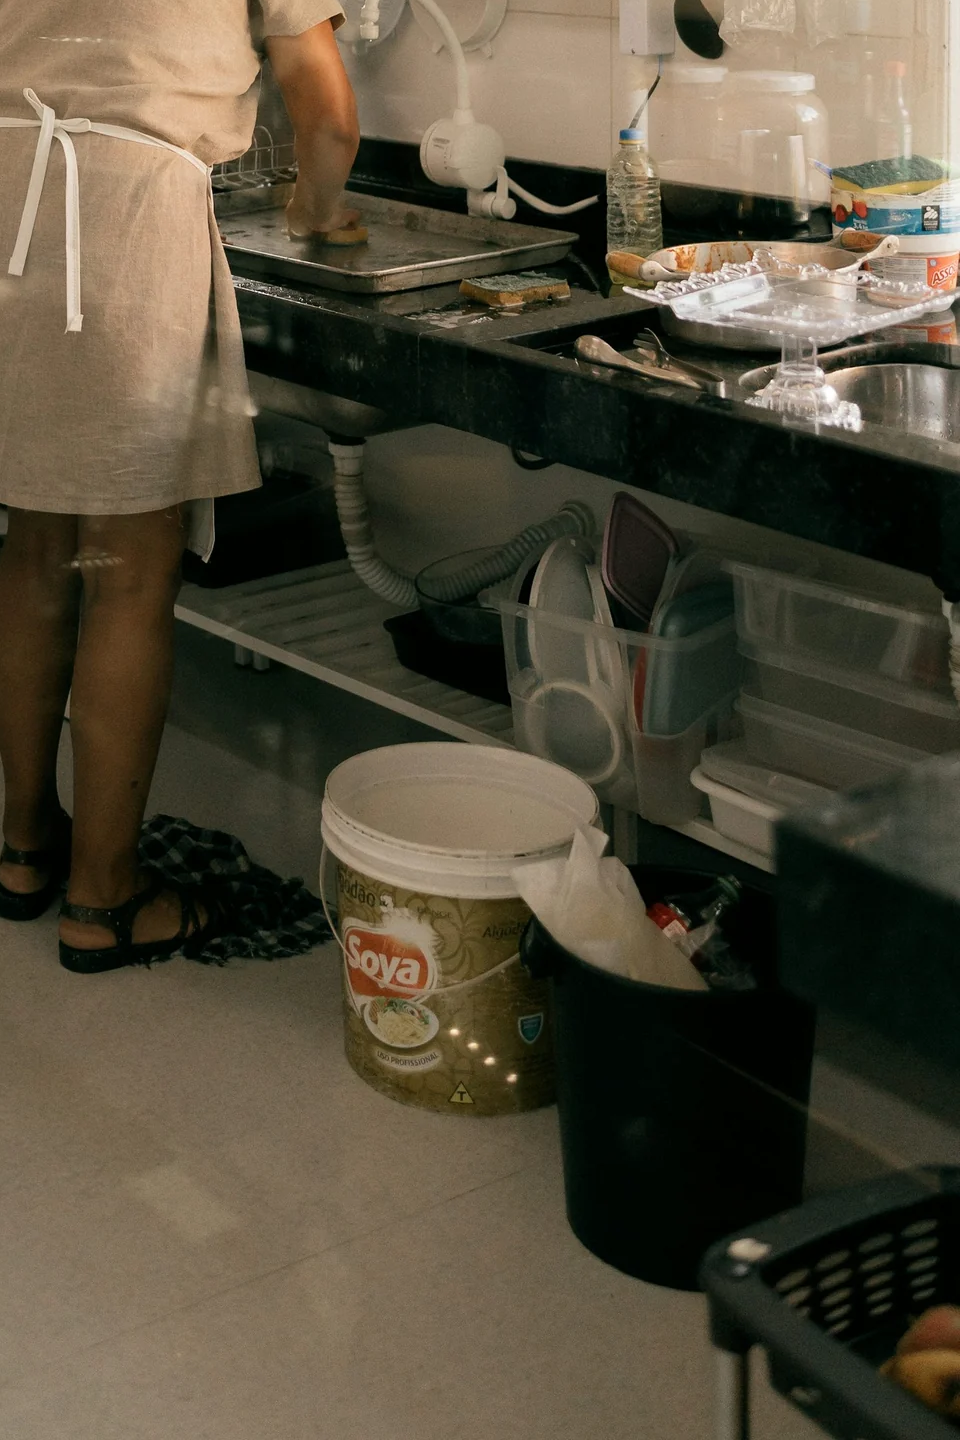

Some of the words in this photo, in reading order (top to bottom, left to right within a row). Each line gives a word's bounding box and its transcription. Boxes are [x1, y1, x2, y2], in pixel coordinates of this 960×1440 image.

[347, 934, 421, 988] Soya
[377, 1050, 390, 1062] USO
[390, 1051, 439, 1067] PROFISSIONAL
[457, 1091, 467, 1101] T
